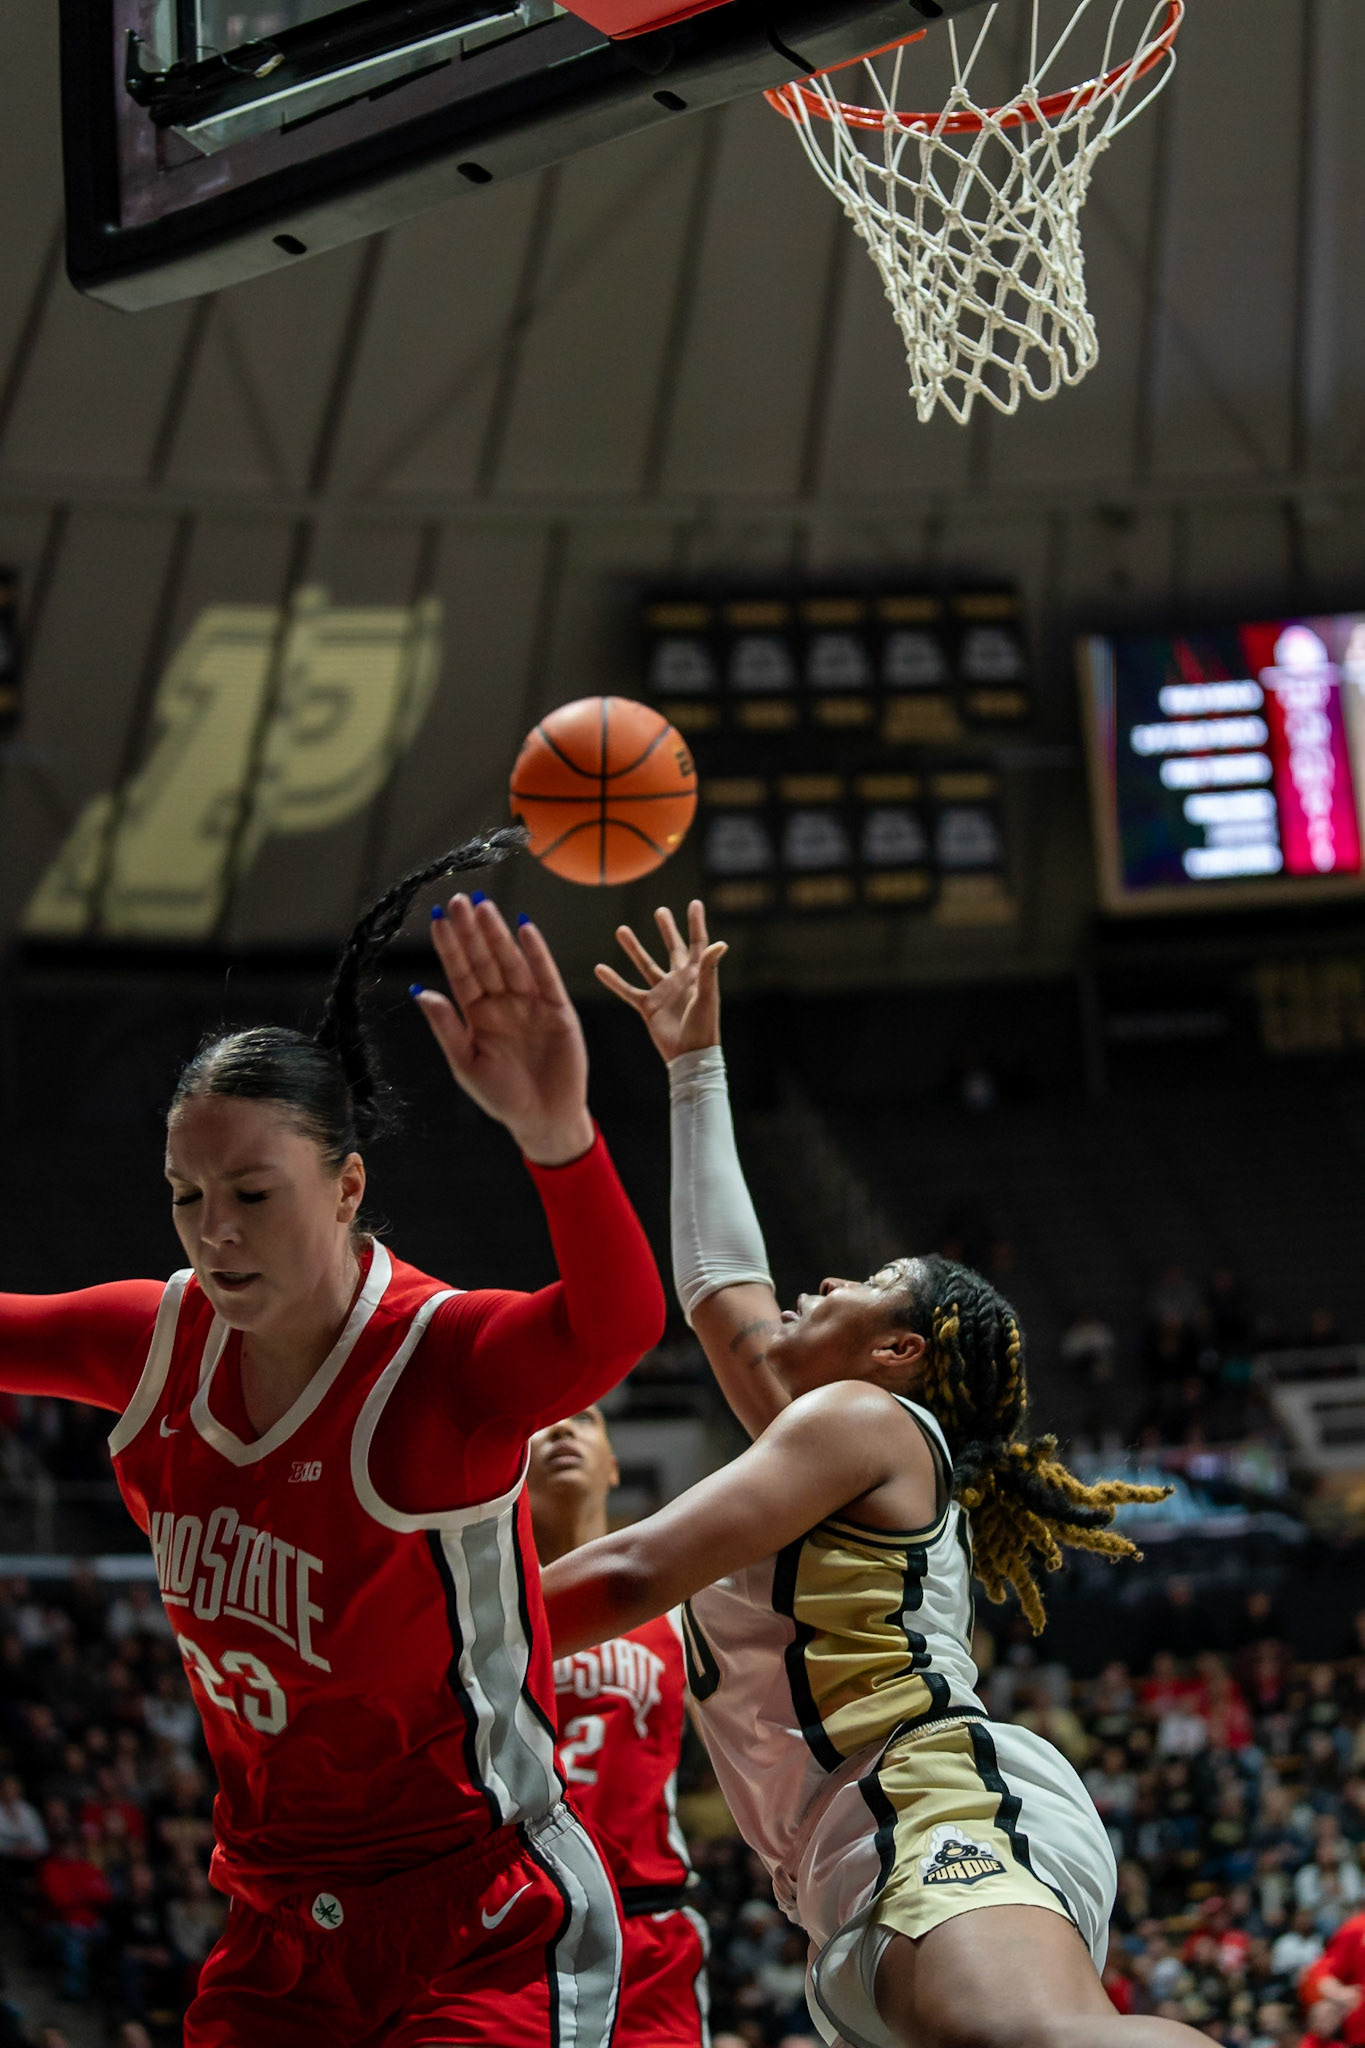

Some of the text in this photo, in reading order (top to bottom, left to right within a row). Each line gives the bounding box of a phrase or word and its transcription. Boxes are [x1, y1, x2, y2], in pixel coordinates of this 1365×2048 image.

[193, 1506, 332, 1673] STATE
[177, 1632, 288, 1736] 23
[927, 1859, 1002, 1882] PURDUE
